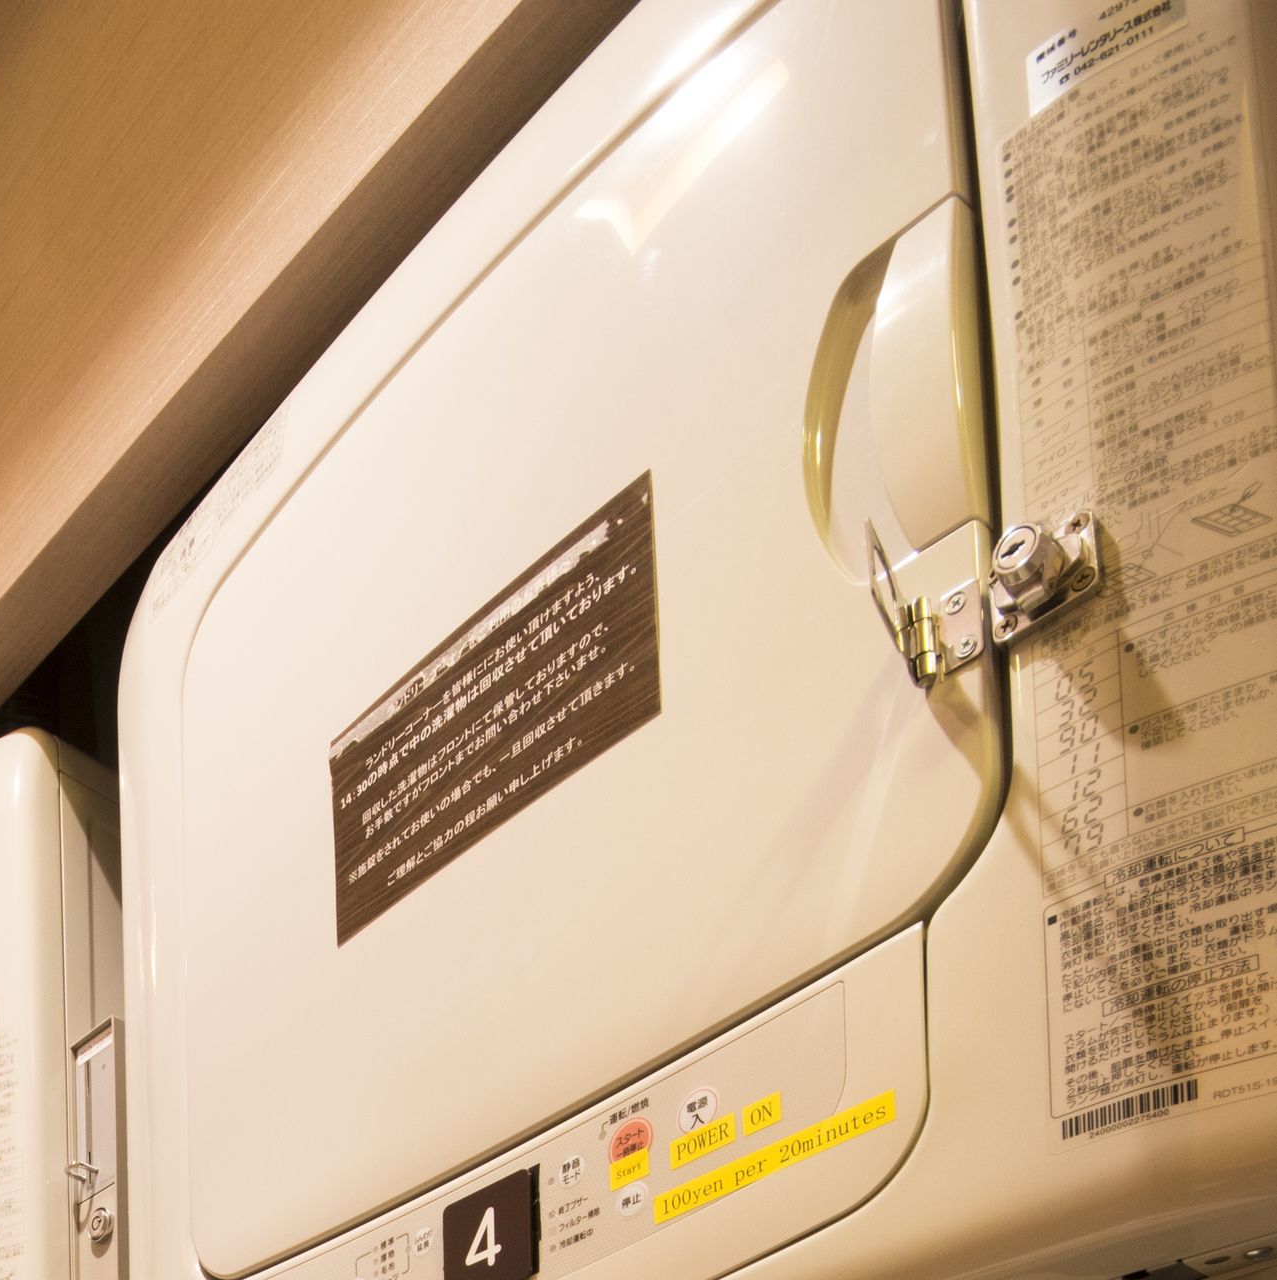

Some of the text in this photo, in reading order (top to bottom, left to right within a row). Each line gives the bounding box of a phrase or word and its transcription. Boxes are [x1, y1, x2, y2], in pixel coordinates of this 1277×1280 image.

[1074, 26, 1154, 75] 042-621-0111
[340, 554, 637, 811] 14:30の時点で中の洗濯物は回収させて頂いております。
[362, 616, 608, 825] 回収した洗濯物はフロントにて保管しておりますので、
[365, 636, 606, 840] お手数ですがフロントまでお問い合わせ下さいませ。
[387, 726, 582, 887] ご理解とご協力の程お願い申し上げます。
[1112, 830, 1235, 884] 冷却運転について
[1110, 956, 1251, 1013] 冷却運転の停止方法
[677, 1102, 773, 1160] POWER ON
[687, 1096, 708, 1113] 電源
[691, 1114, 704, 1129] 入
[616, 1127, 644, 1148] スタート
[663, 1102, 889, 1215] 100yen per 20minutes
[562, 1158, 580, 1174] 静音
[563, 1170, 581, 1184] モード
[616, 1163, 642, 1180] Start
[621, 1193, 641, 1209] 停止
[464, 1206, 503, 1268] 4
